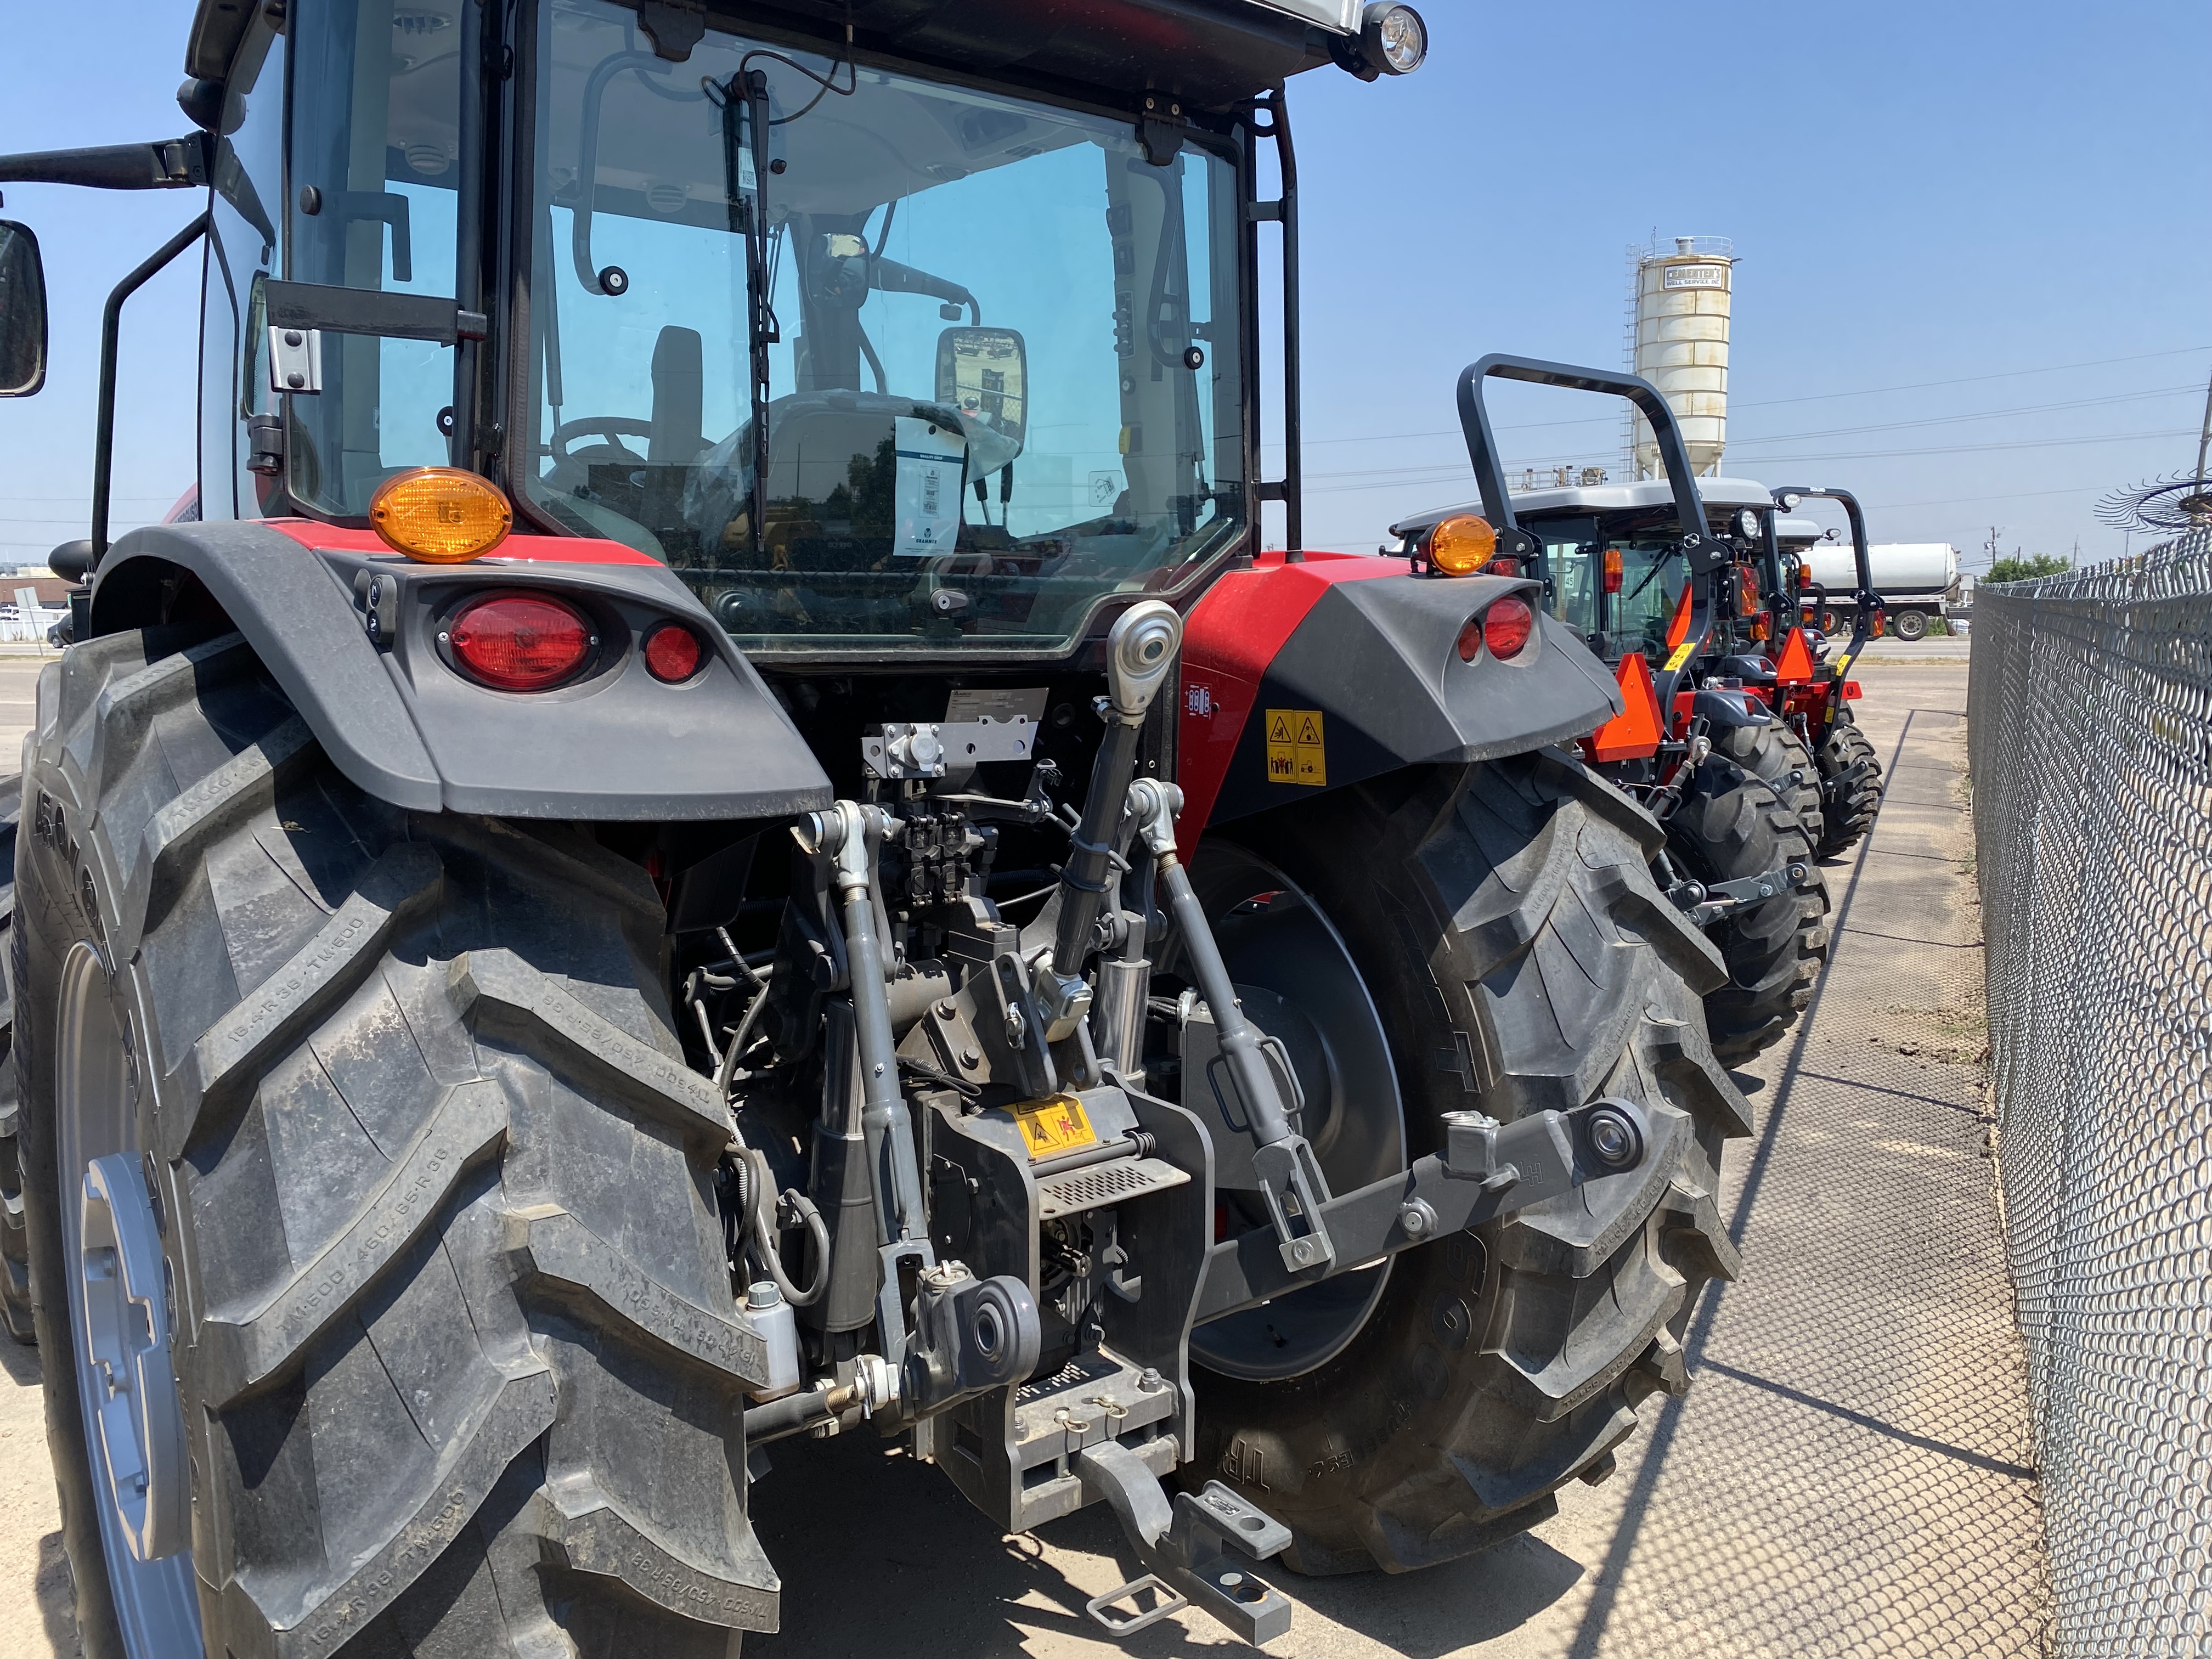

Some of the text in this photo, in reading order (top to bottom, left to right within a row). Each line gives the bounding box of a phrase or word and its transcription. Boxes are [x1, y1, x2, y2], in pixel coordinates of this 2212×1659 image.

[1566, 577, 1573, 586] 45
[276, 978, 301, 999] 38
[426, 1147, 448, 1172] 38
